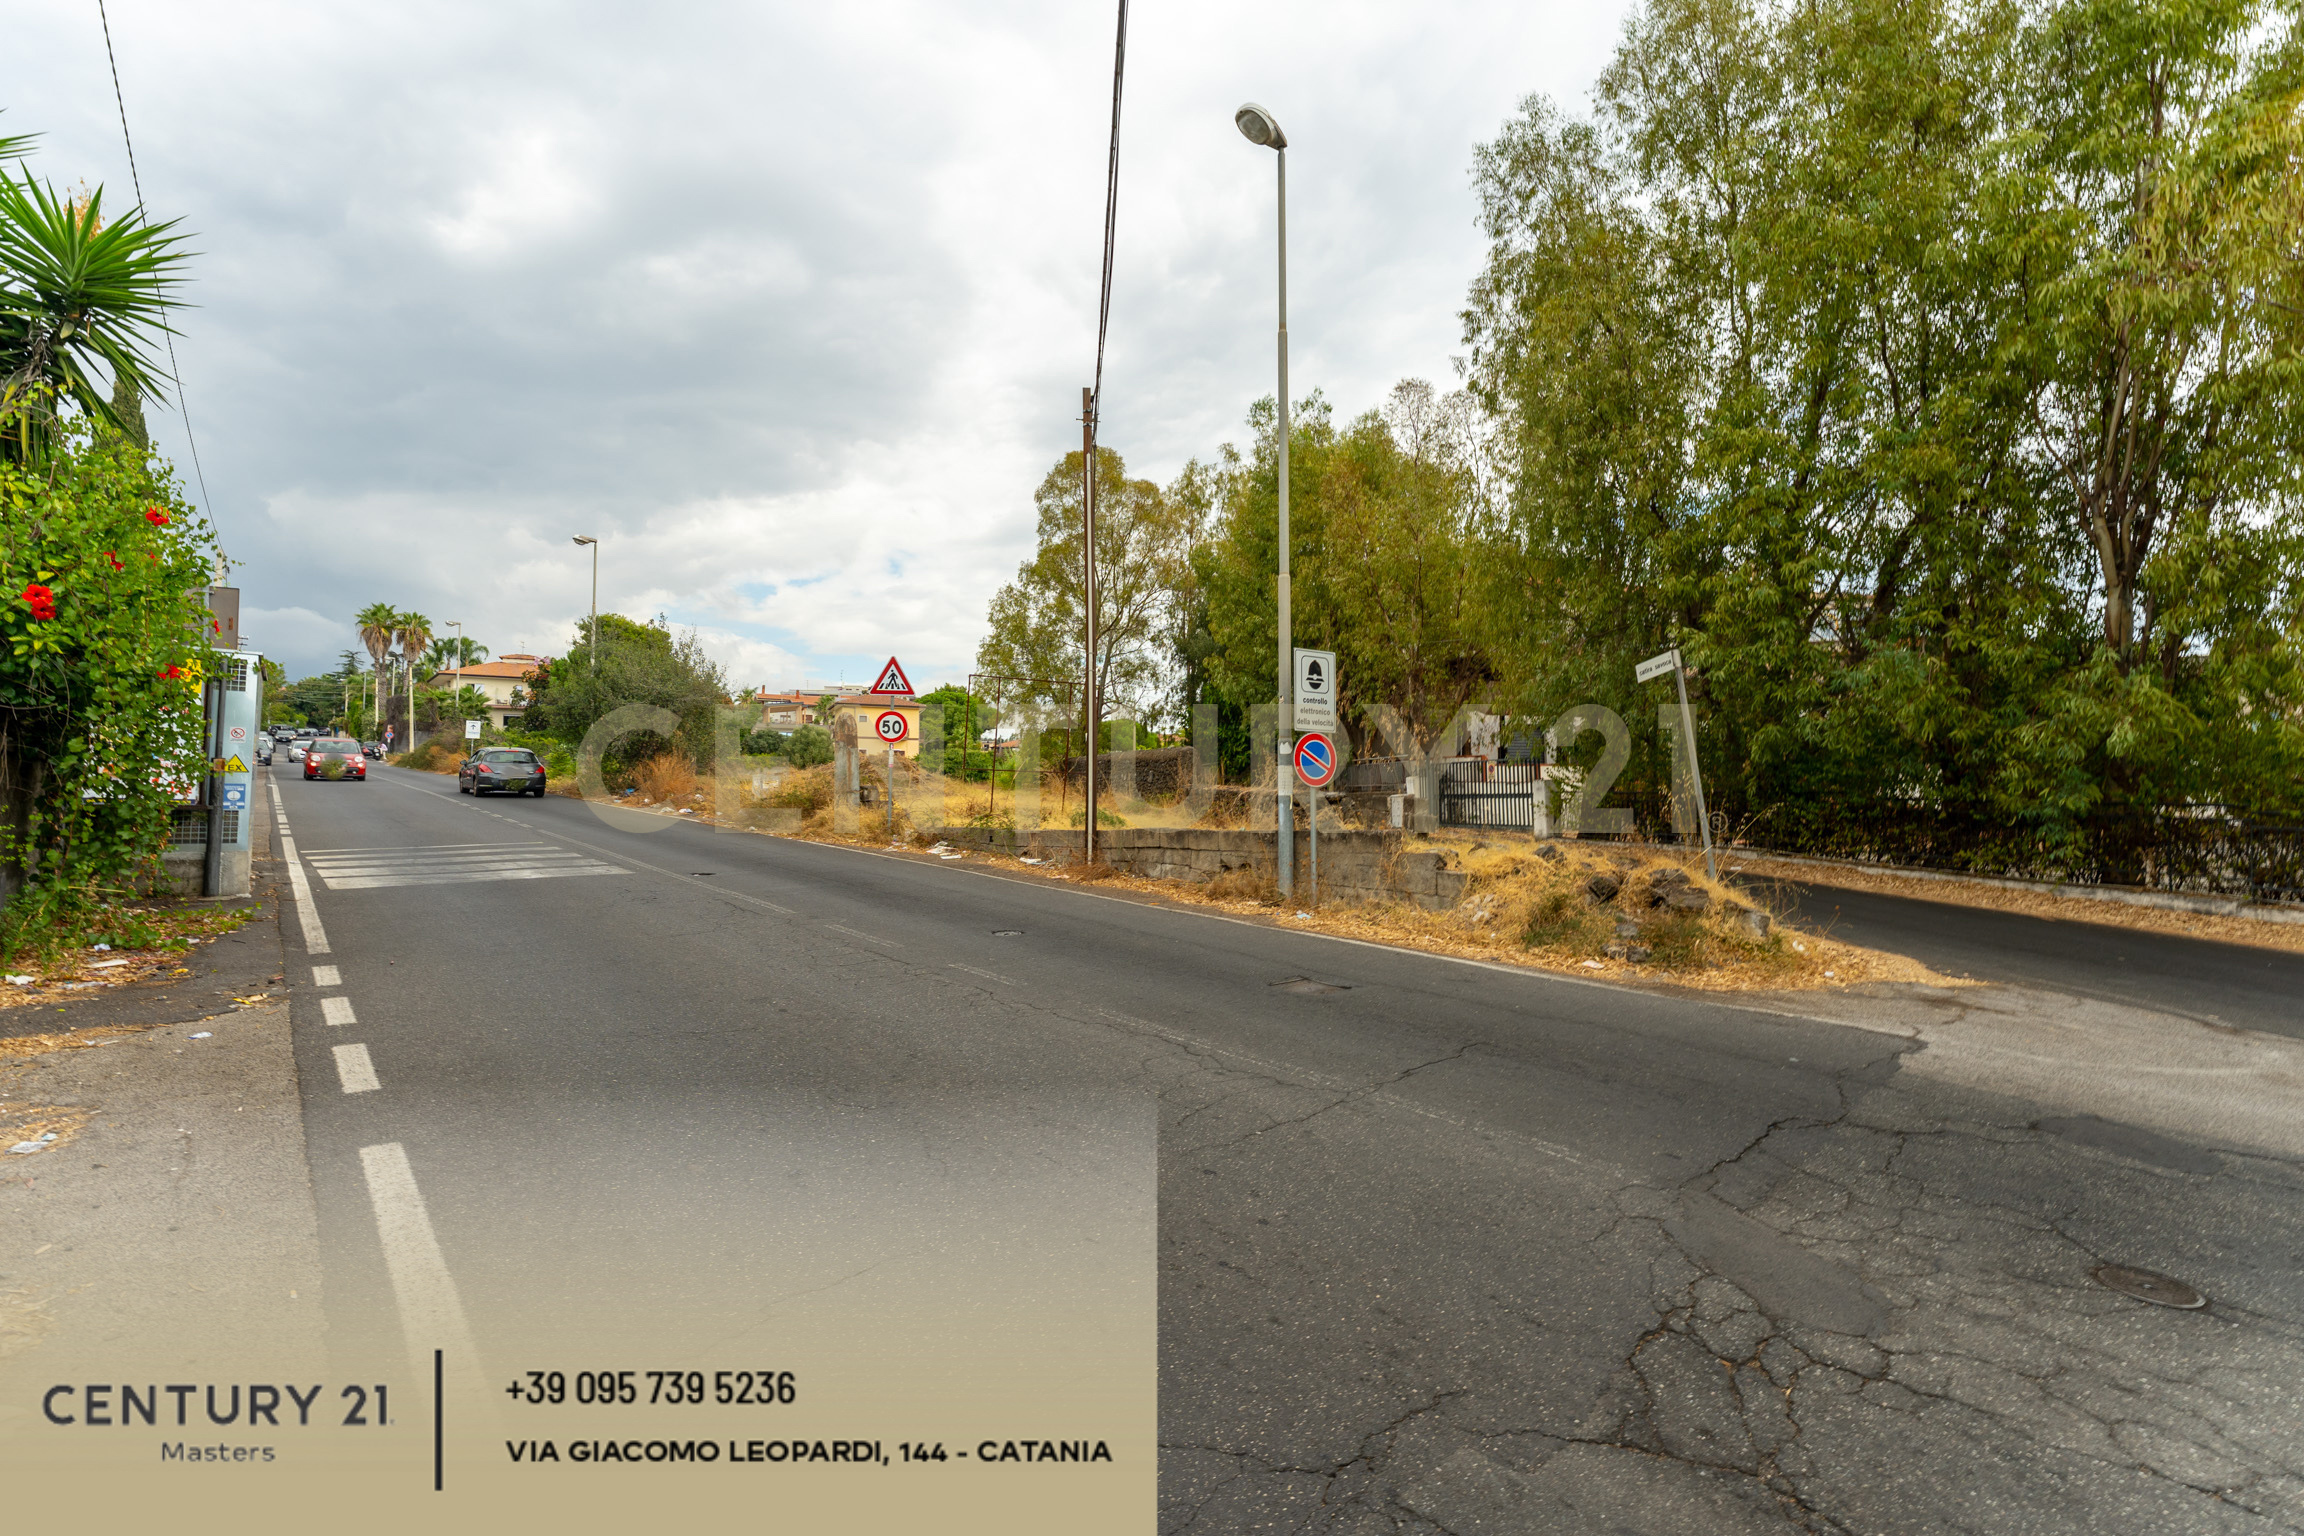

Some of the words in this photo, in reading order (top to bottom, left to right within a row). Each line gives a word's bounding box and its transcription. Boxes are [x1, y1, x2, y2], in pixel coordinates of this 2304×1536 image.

[1303, 697, 1328, 705] controllo
[1300, 707, 1330, 716] elettronico
[1297, 717, 1310, 725] della
[882, 720, 902, 734] 50
